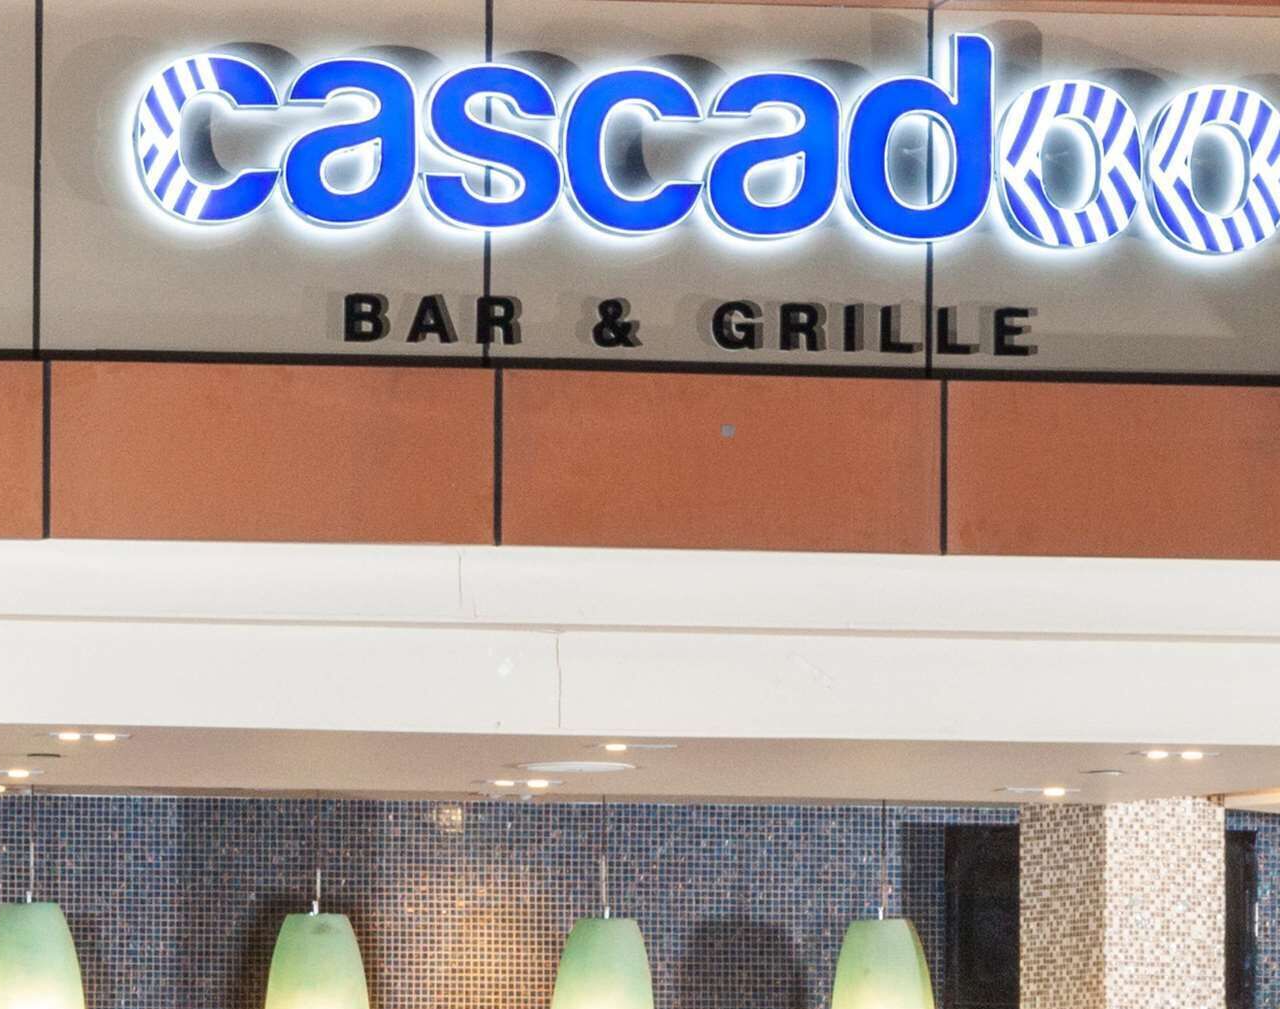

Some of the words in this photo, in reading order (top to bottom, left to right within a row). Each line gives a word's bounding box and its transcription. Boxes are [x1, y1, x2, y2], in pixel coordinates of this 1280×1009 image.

[343, 293, 518, 344] BAR
[592, 298, 634, 347] &
[712, 300, 1031, 356] GRILLE
